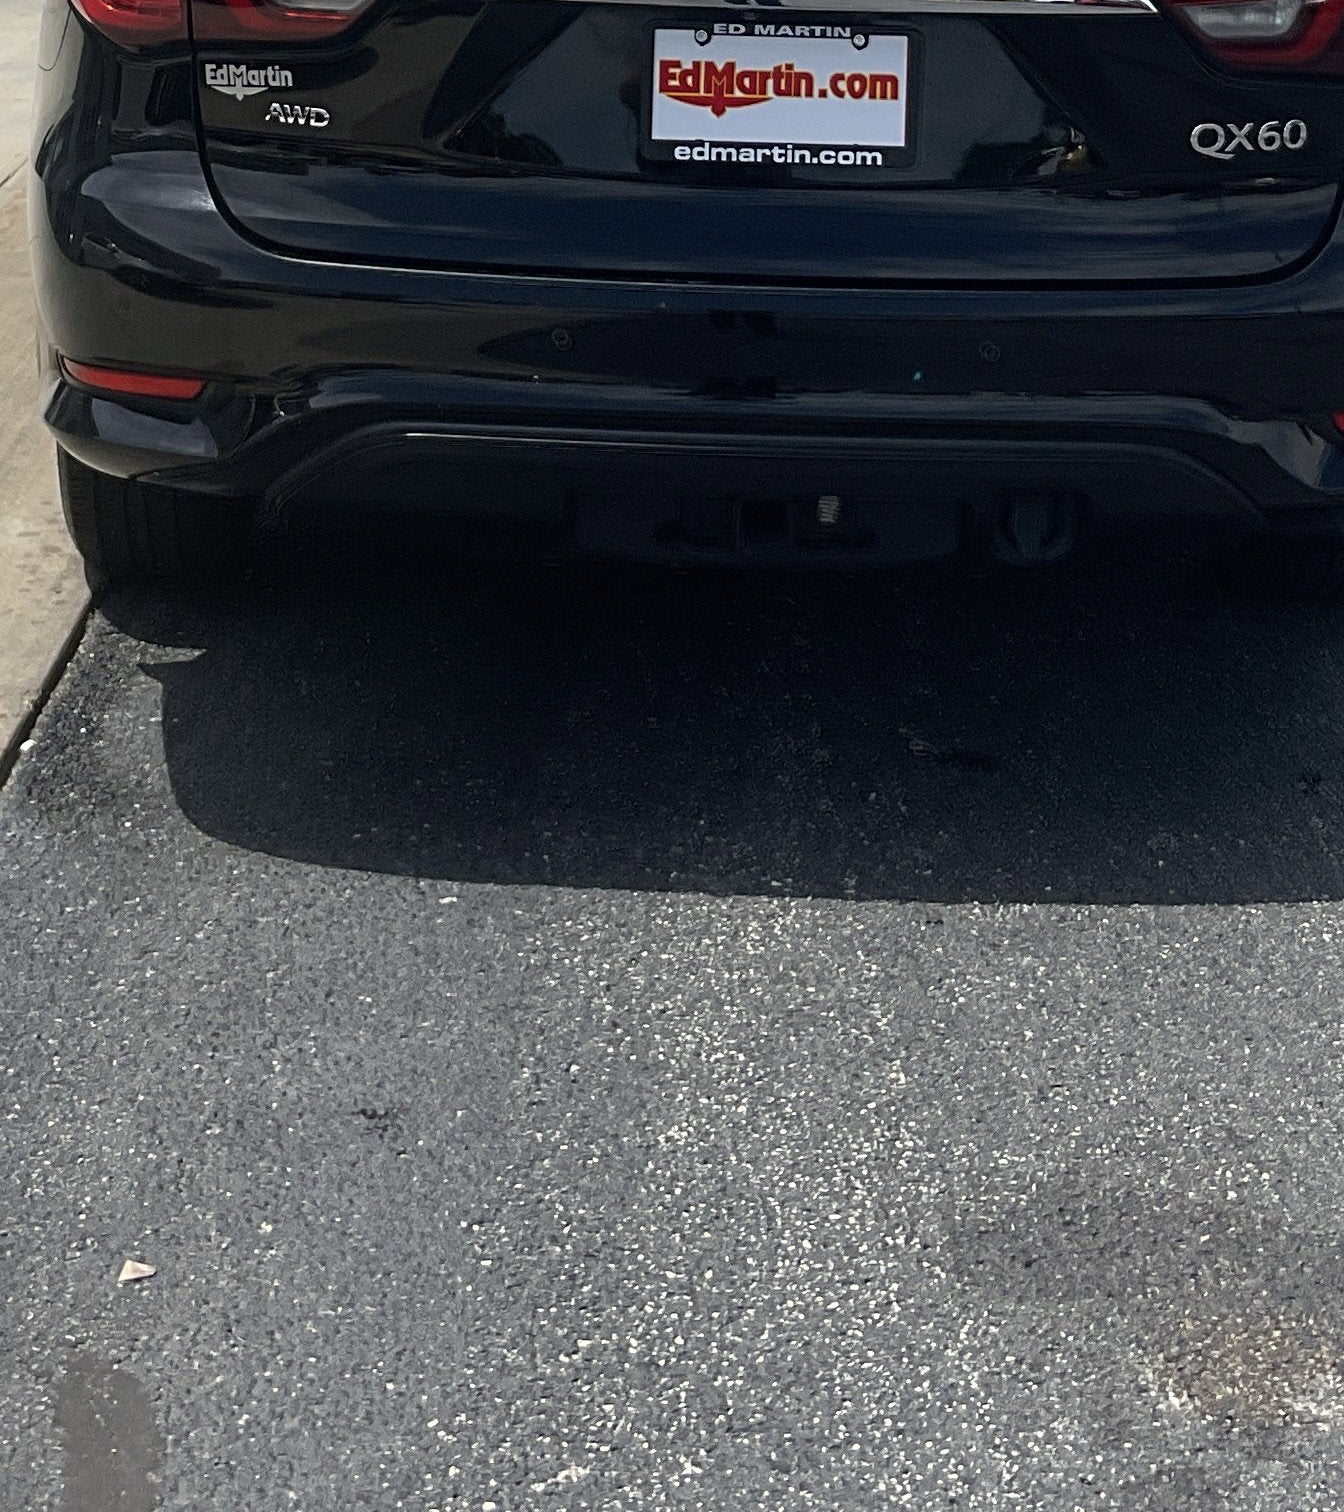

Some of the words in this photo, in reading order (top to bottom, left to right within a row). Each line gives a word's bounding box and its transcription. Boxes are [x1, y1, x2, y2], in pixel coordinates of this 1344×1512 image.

[713, 22, 747, 35] ED
[754, 24, 852, 38] MARTIN
[205, 63, 294, 91] EdMartin
[658, 59, 899, 102] EdMartin.com
[264, 102, 331, 128] AWD
[1189, 118, 1308, 160] QX60
[673, 141, 884, 167] edmartin.com
